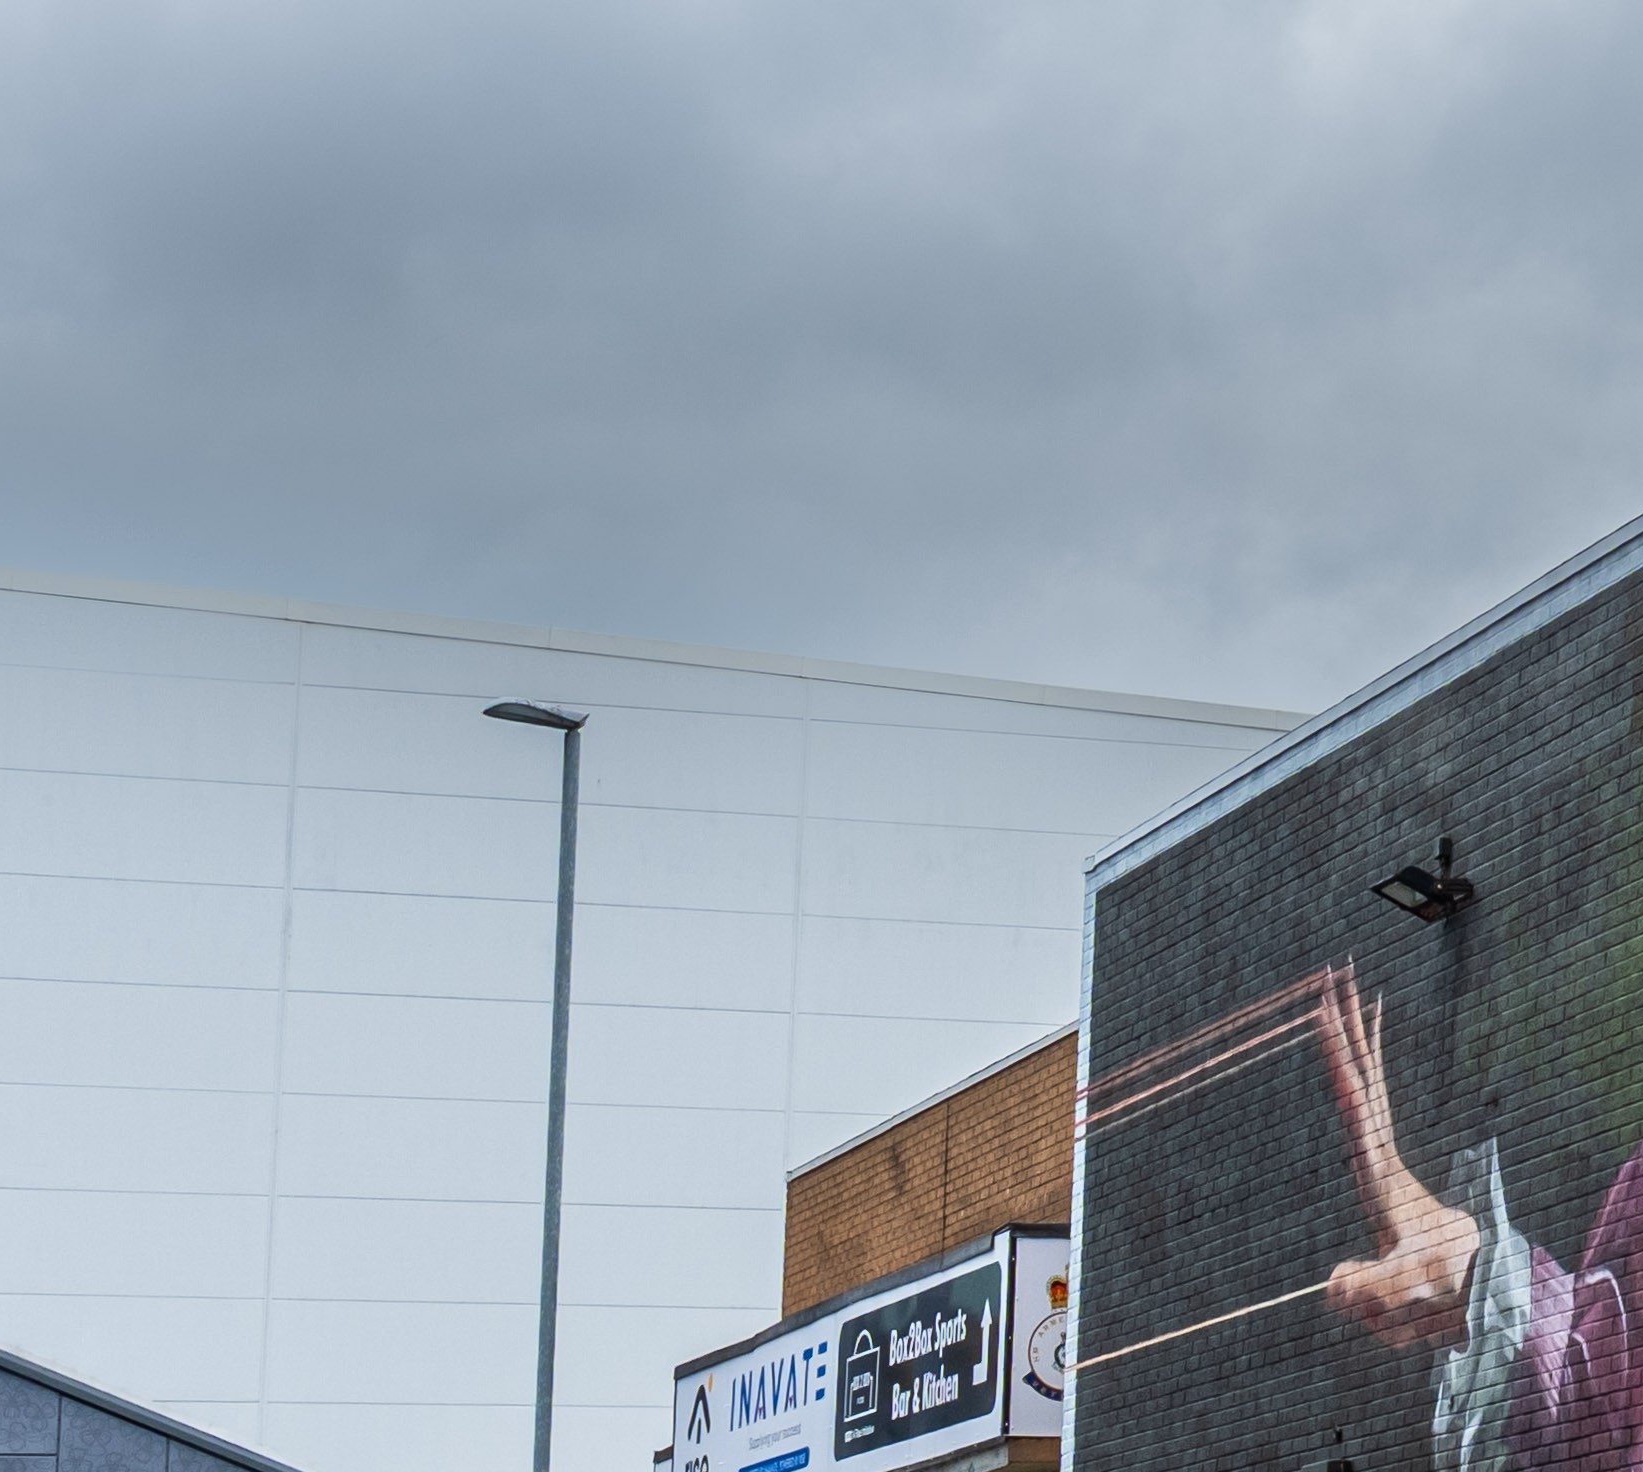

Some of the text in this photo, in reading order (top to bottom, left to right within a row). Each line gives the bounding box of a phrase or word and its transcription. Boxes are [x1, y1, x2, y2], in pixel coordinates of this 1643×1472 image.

[889, 1308, 967, 1367] Box2Box Sports
[729, 1341, 829, 1432] INAVATE
[891, 1382, 911, 1421] Bar
[912, 1377, 921, 1413] &
[921, 1364, 959, 1411] Kitchen
